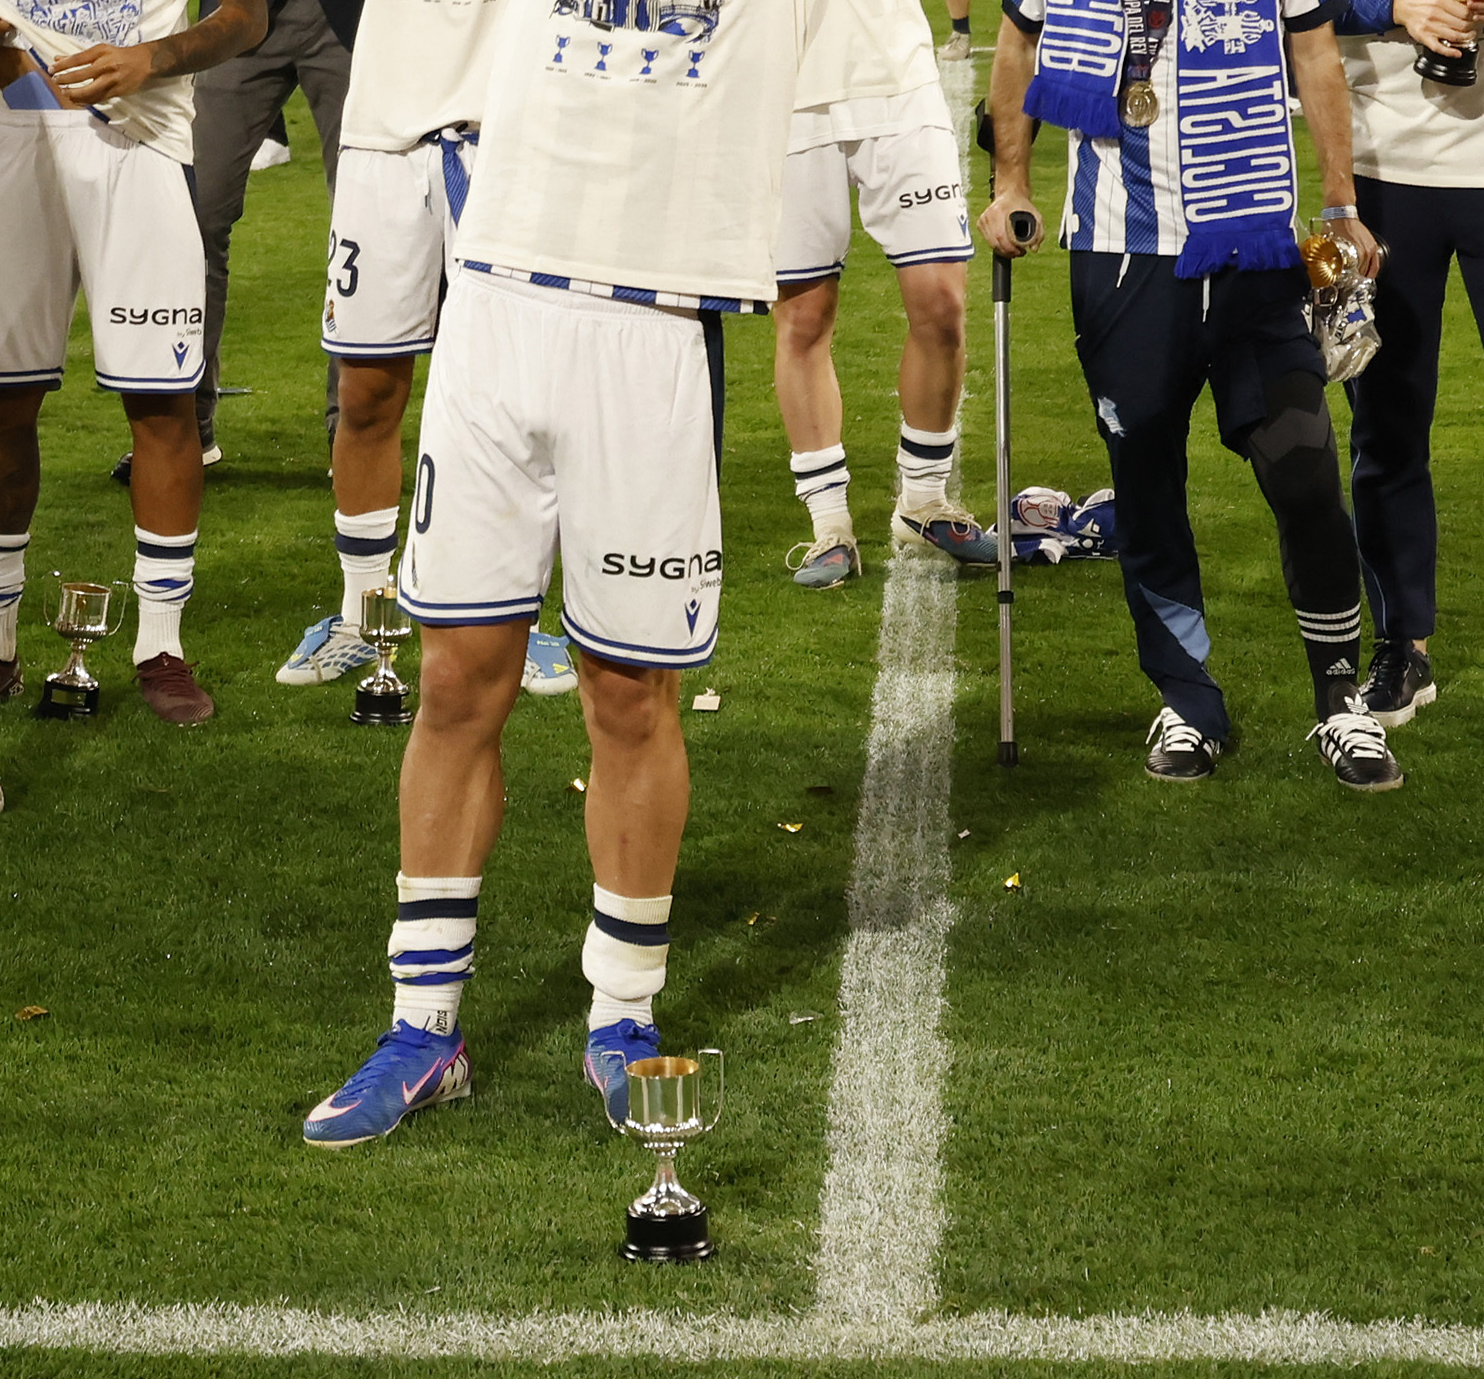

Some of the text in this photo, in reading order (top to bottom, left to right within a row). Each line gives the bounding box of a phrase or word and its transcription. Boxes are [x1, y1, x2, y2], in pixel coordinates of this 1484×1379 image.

[1129, 35, 1147, 56] REY
[109, 305, 204, 326] sygna
[602, 549, 723, 581] sygna
